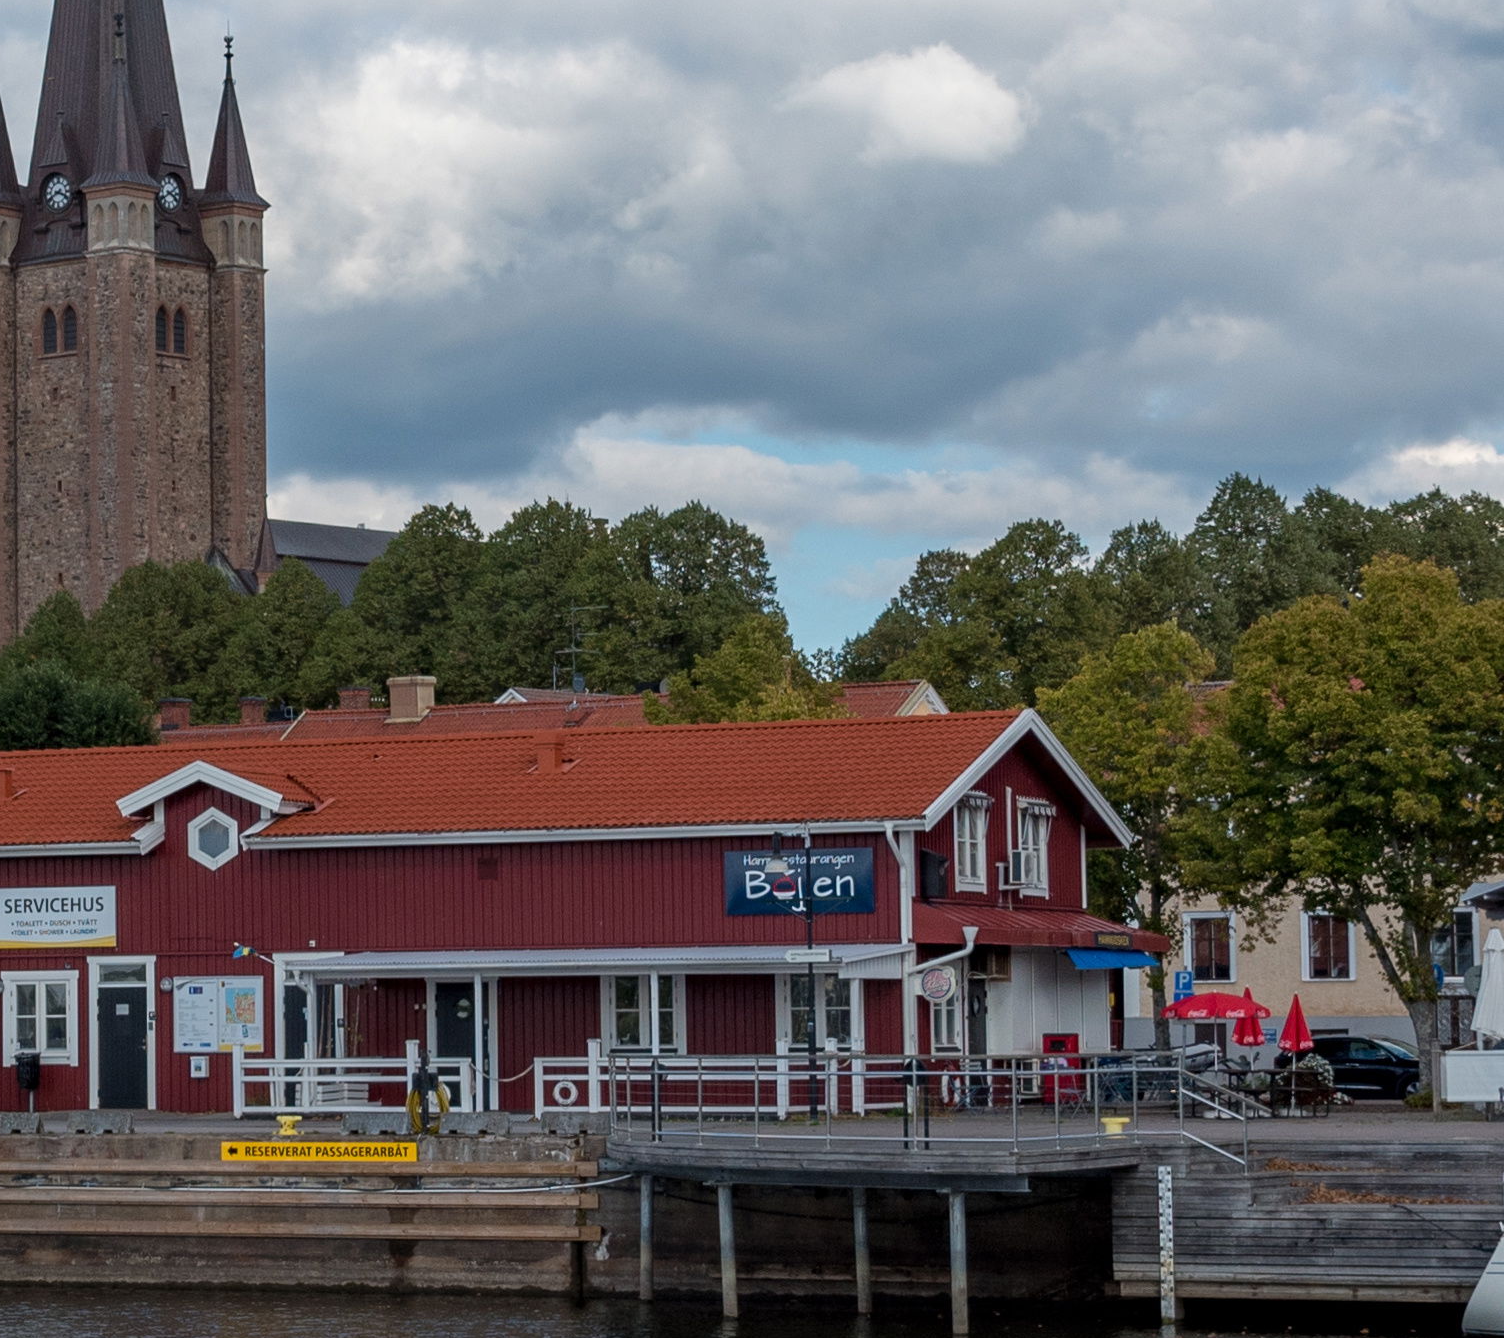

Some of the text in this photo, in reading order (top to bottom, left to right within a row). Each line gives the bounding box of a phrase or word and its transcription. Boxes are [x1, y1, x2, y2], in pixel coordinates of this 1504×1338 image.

[743, 854, 855, 870] Hamestaurangen
[4, 896, 104, 914] SERVICEHUS
[1179, 973, 1190, 989] P
[244, 1144, 409, 1158] RESERVERAT PASSAGERARBÅT
